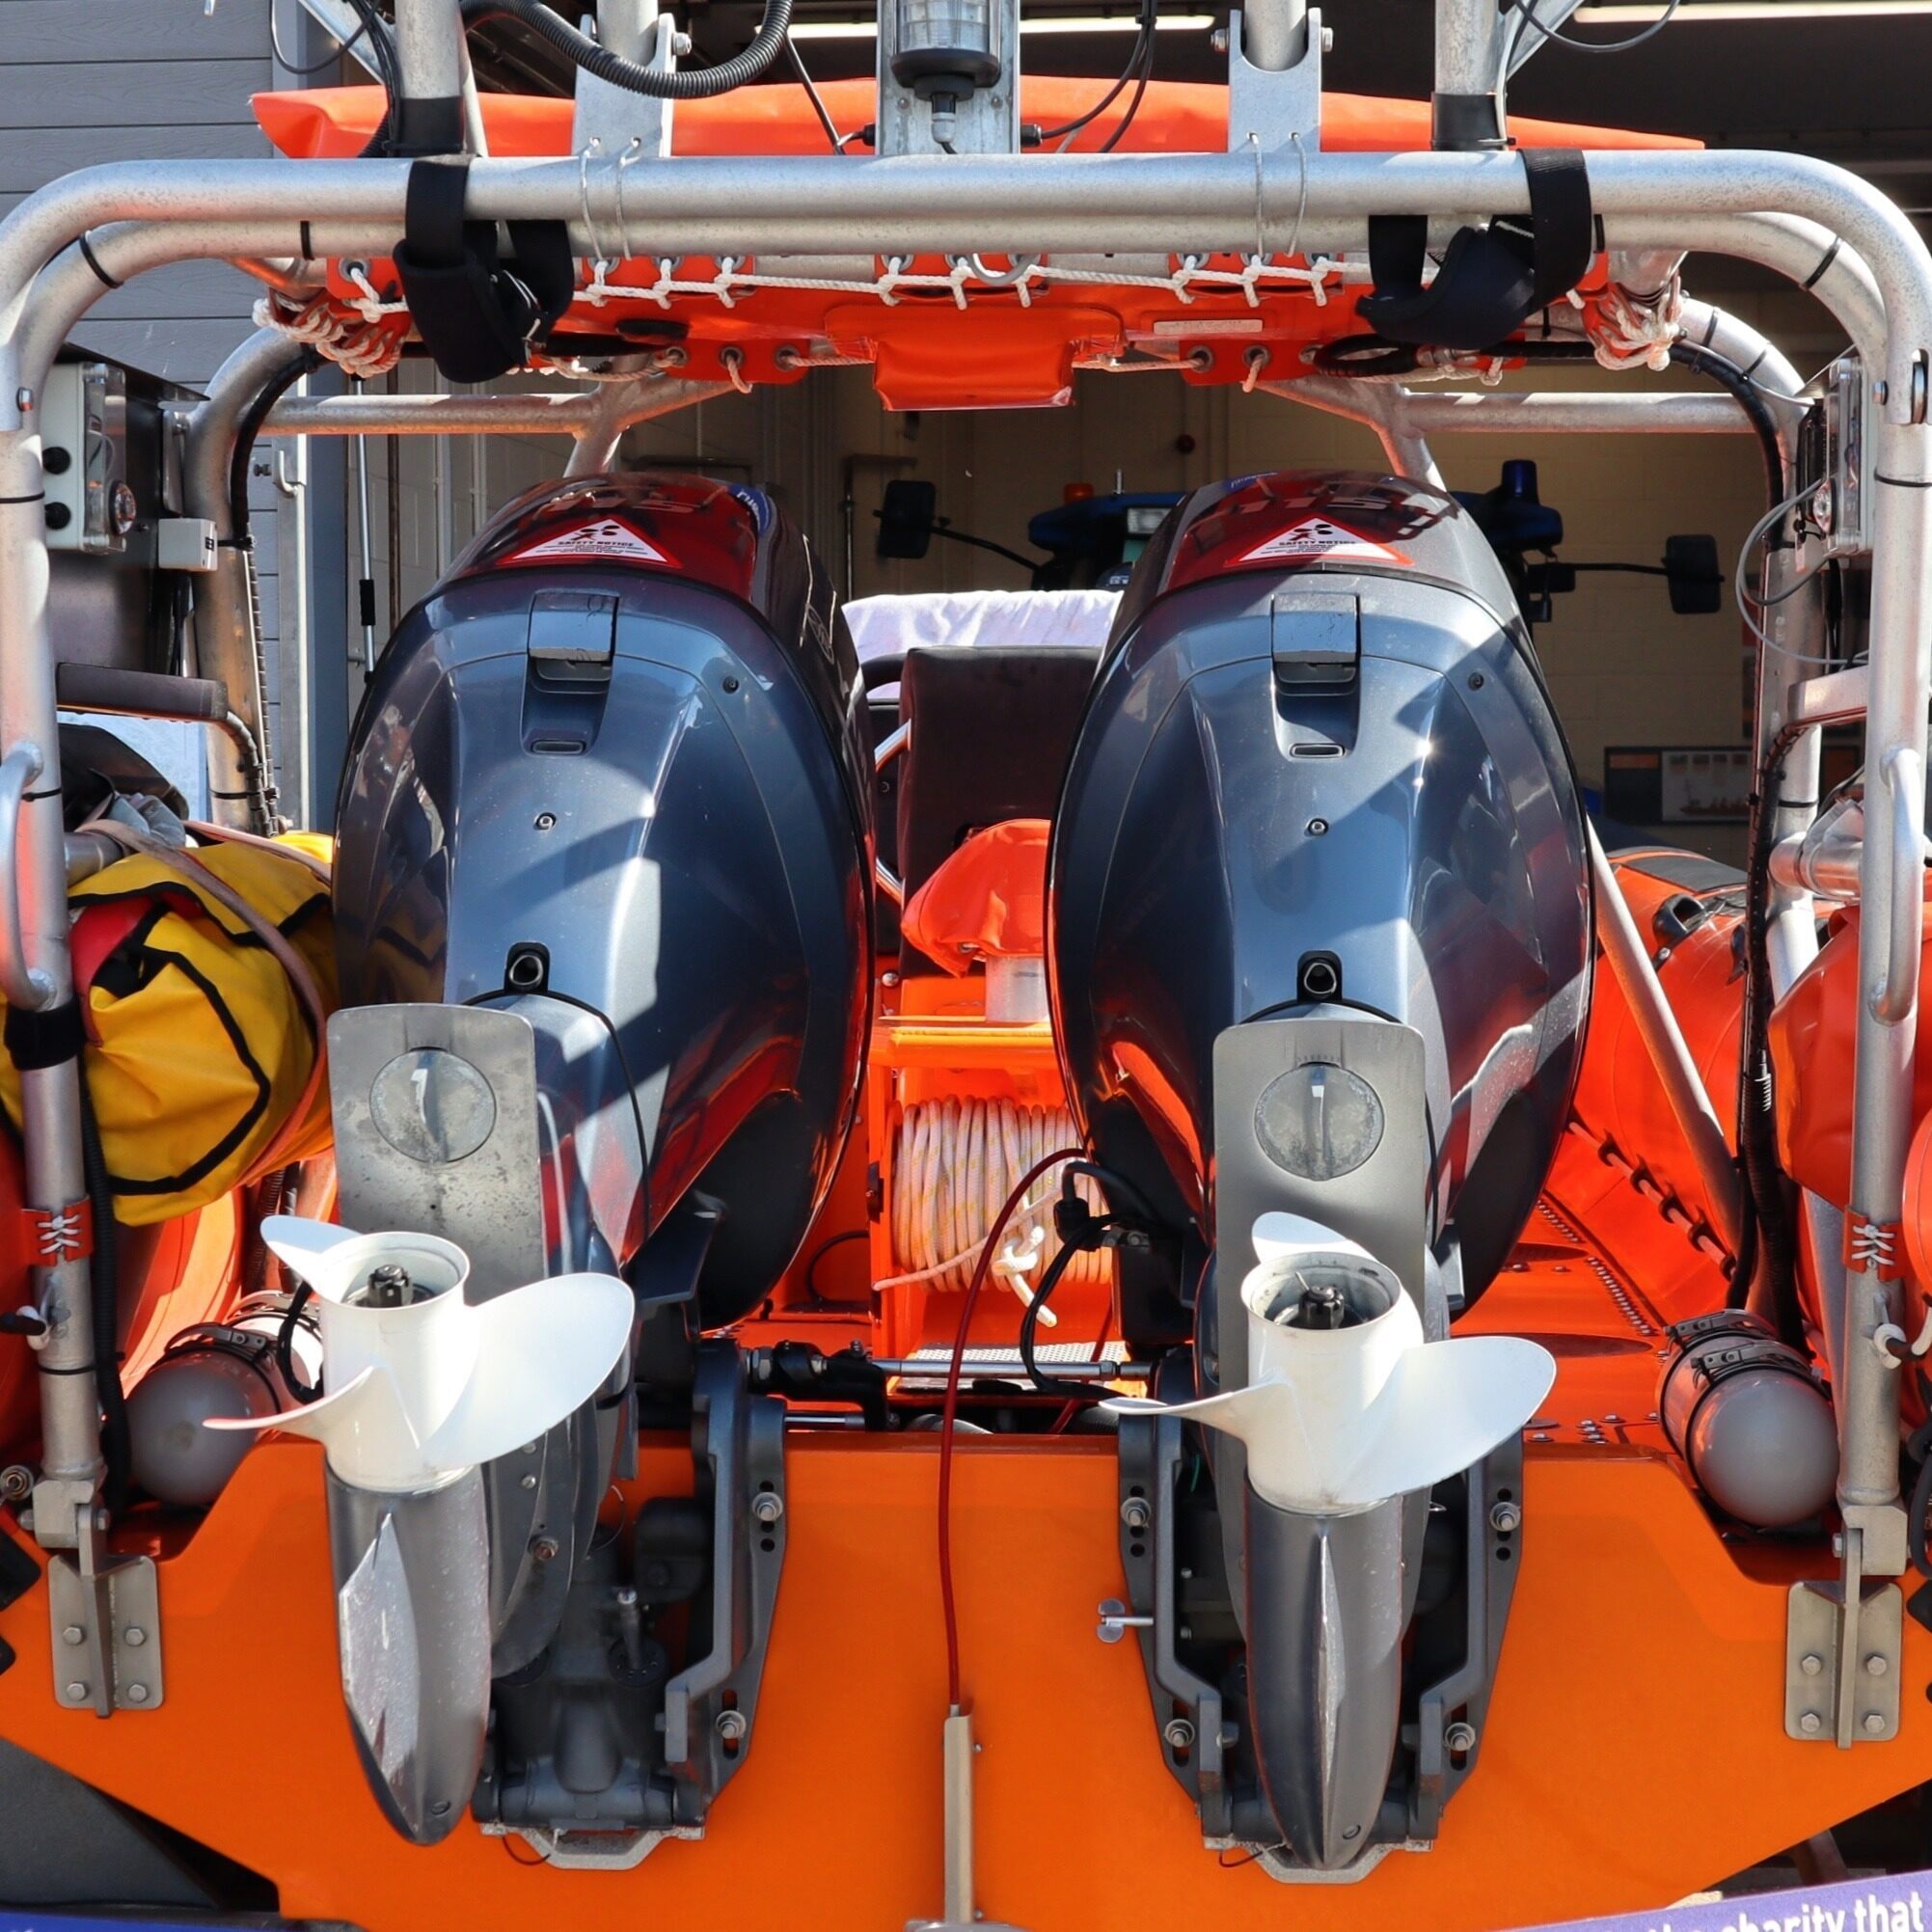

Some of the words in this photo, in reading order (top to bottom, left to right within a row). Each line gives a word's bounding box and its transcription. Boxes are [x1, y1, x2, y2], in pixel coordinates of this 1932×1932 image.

[1240, 496, 1392, 515] 115
[1722, 1903, 1845, 1932] rity
[1854, 1891, 1924, 1932] that
